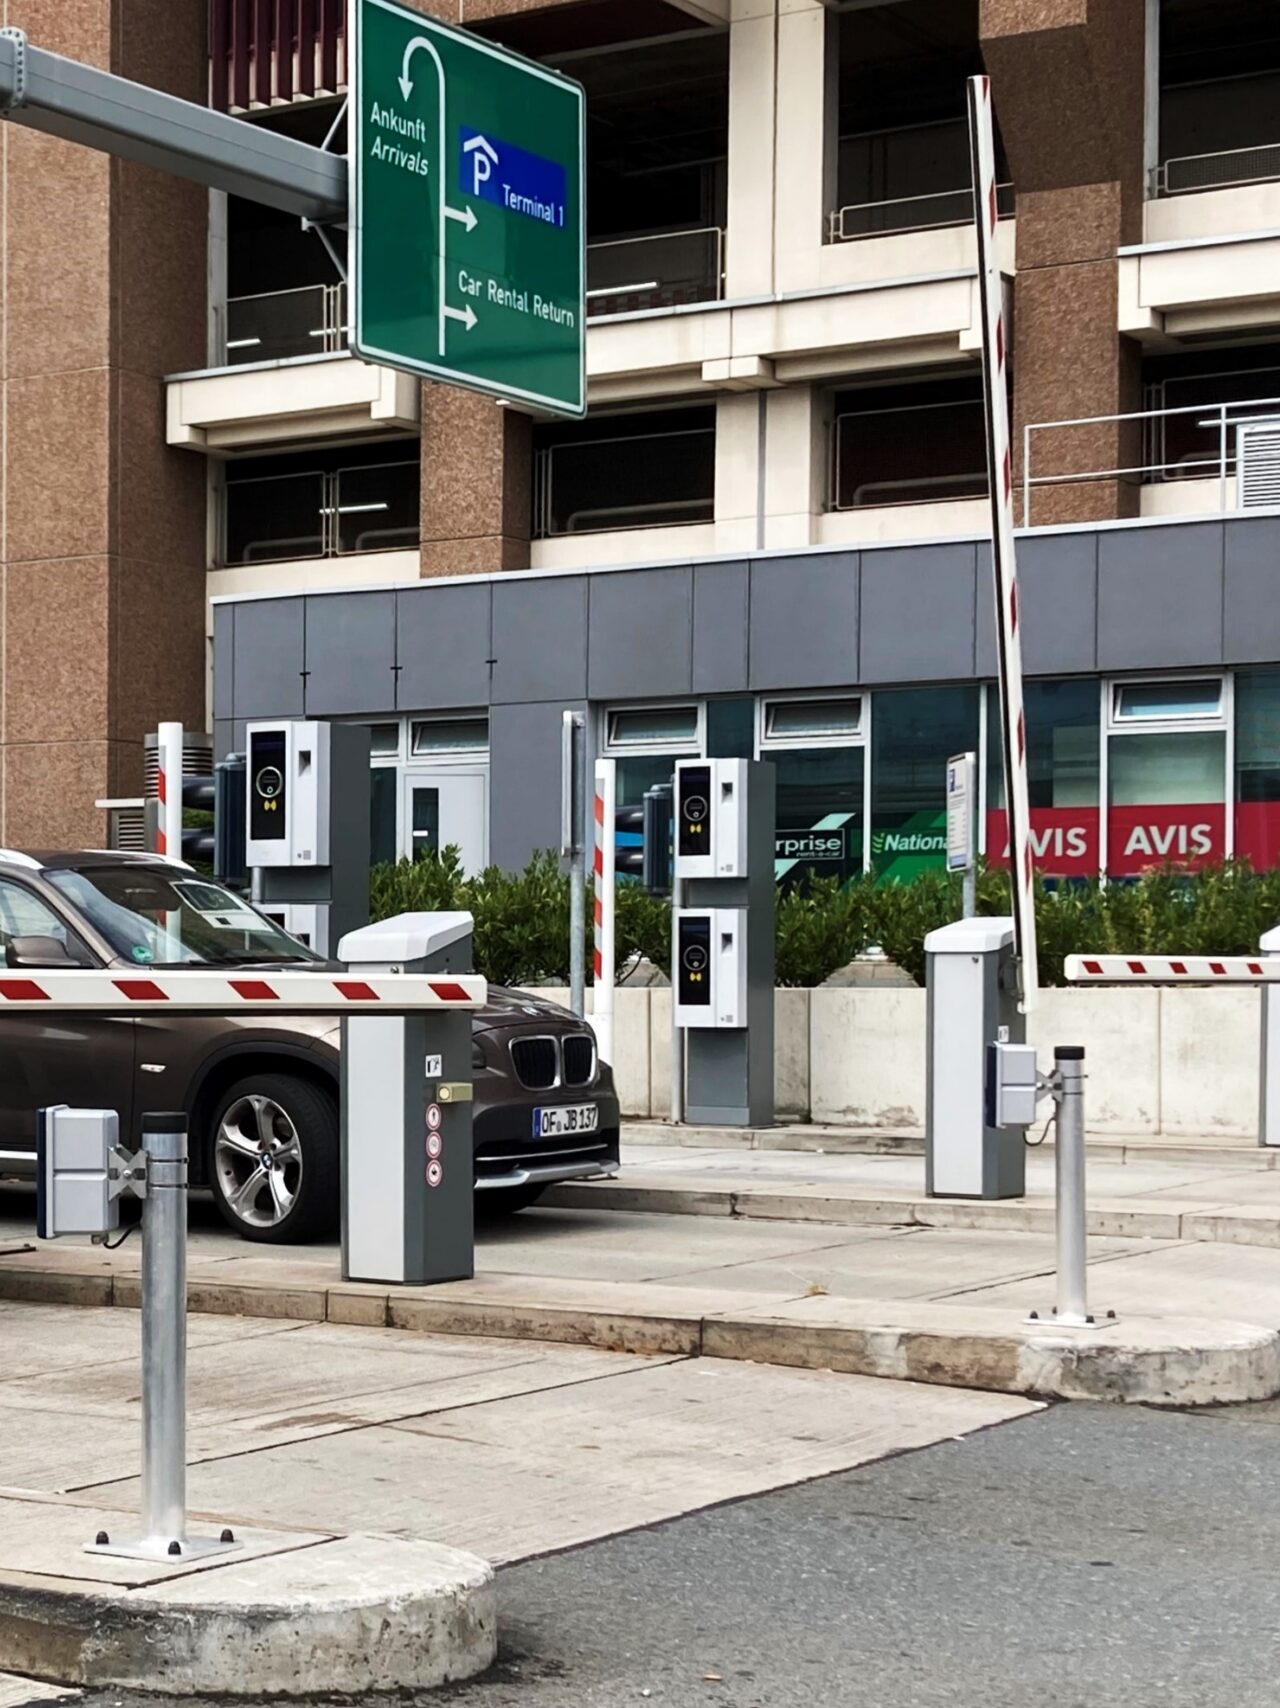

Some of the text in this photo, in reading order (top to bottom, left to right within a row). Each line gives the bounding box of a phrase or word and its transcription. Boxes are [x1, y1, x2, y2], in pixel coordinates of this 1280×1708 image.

[370, 101, 427, 143] Ankunft
[370, 136, 429, 177] Arrivals
[472, 152, 491, 196] P
[502, 183, 564, 226] Terminal 1
[458, 271, 574, 329] Car Rental Return
[1123, 823, 1213, 856] AVIS
[542, 1106, 596, 1133] OF JB 137
